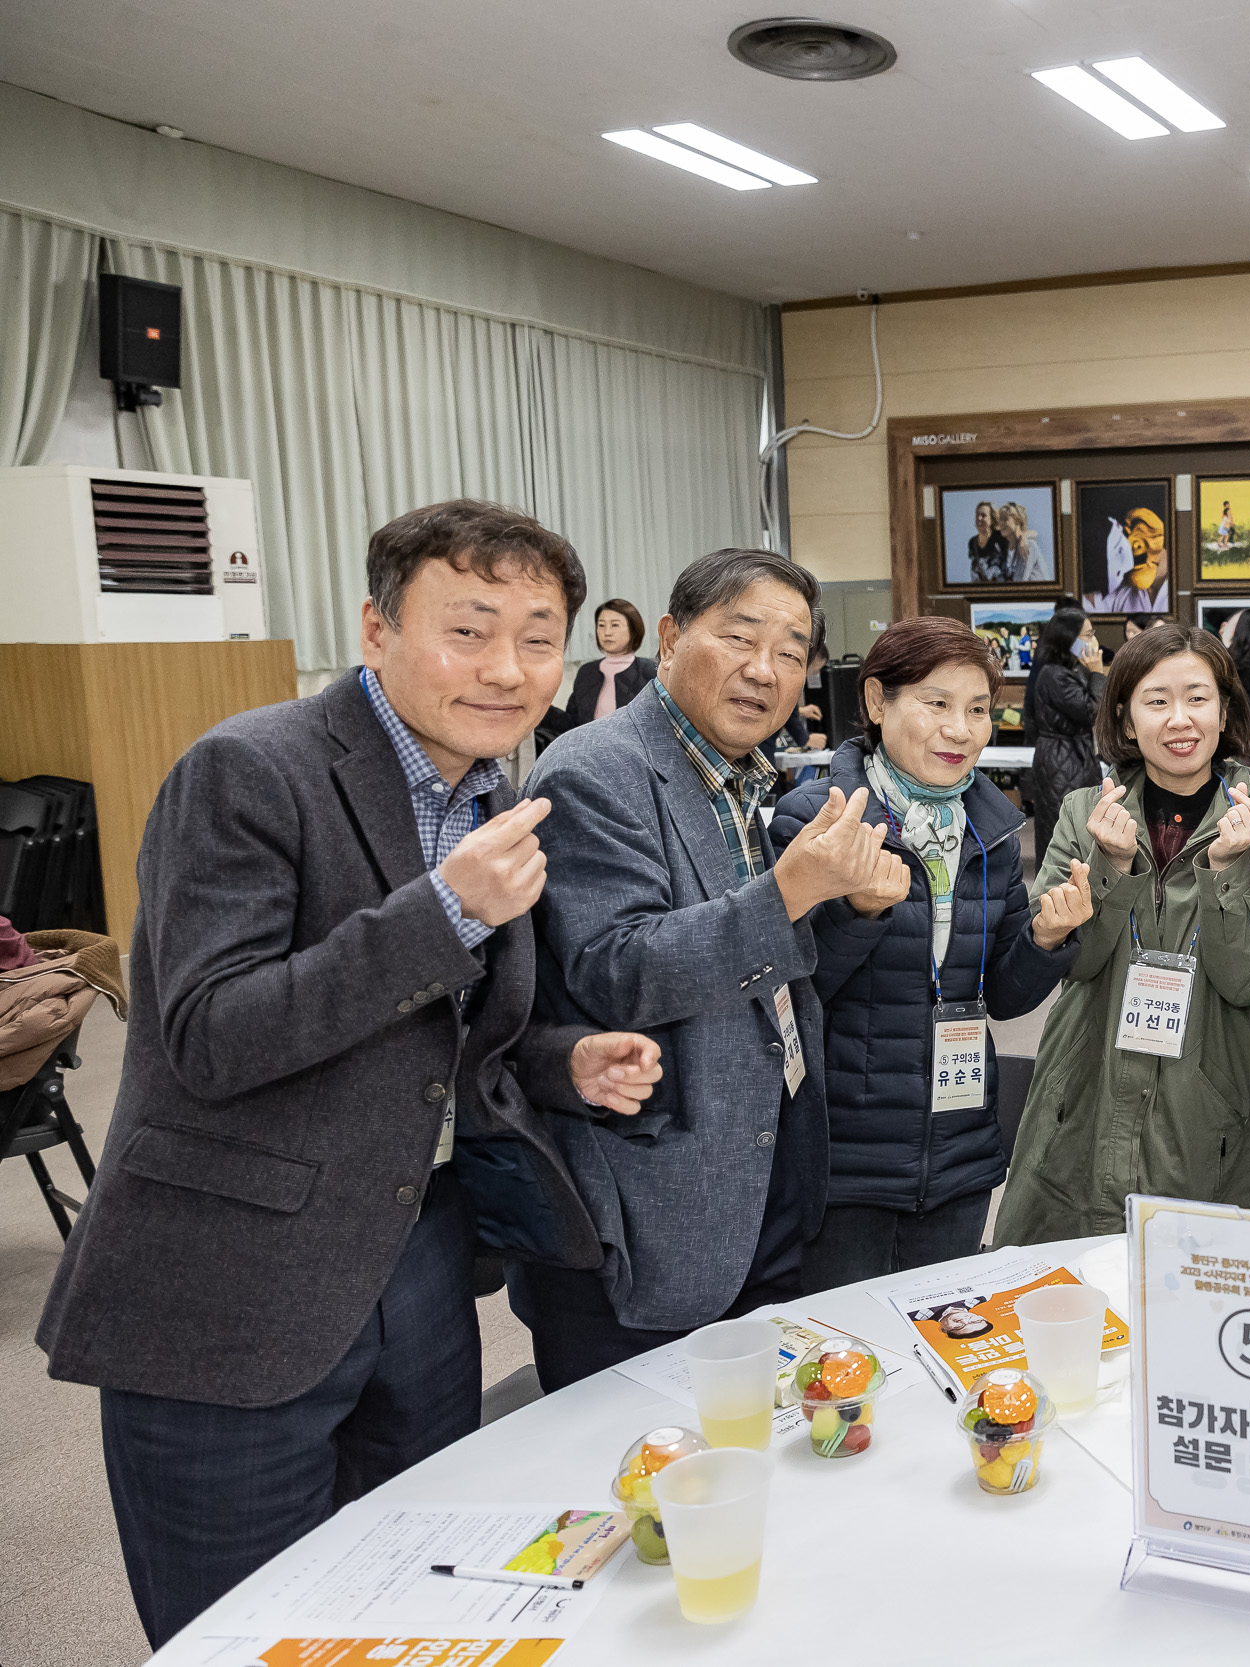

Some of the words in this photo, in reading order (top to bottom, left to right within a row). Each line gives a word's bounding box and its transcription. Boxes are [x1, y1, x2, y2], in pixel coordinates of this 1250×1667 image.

[912, 434, 938, 447] MISO
[937, 432, 978, 445] GALLERY
[1144, 998, 1181, 1014] 구의3동
[951, 1052, 981, 1065] 구의3동
[1180, 1265, 1201, 1277] 2023
[954, 1348, 1002, 1366] 만든
[1156, 1395, 1250, 1439] 참가자
[1173, 1435, 1232, 1473] 설문
